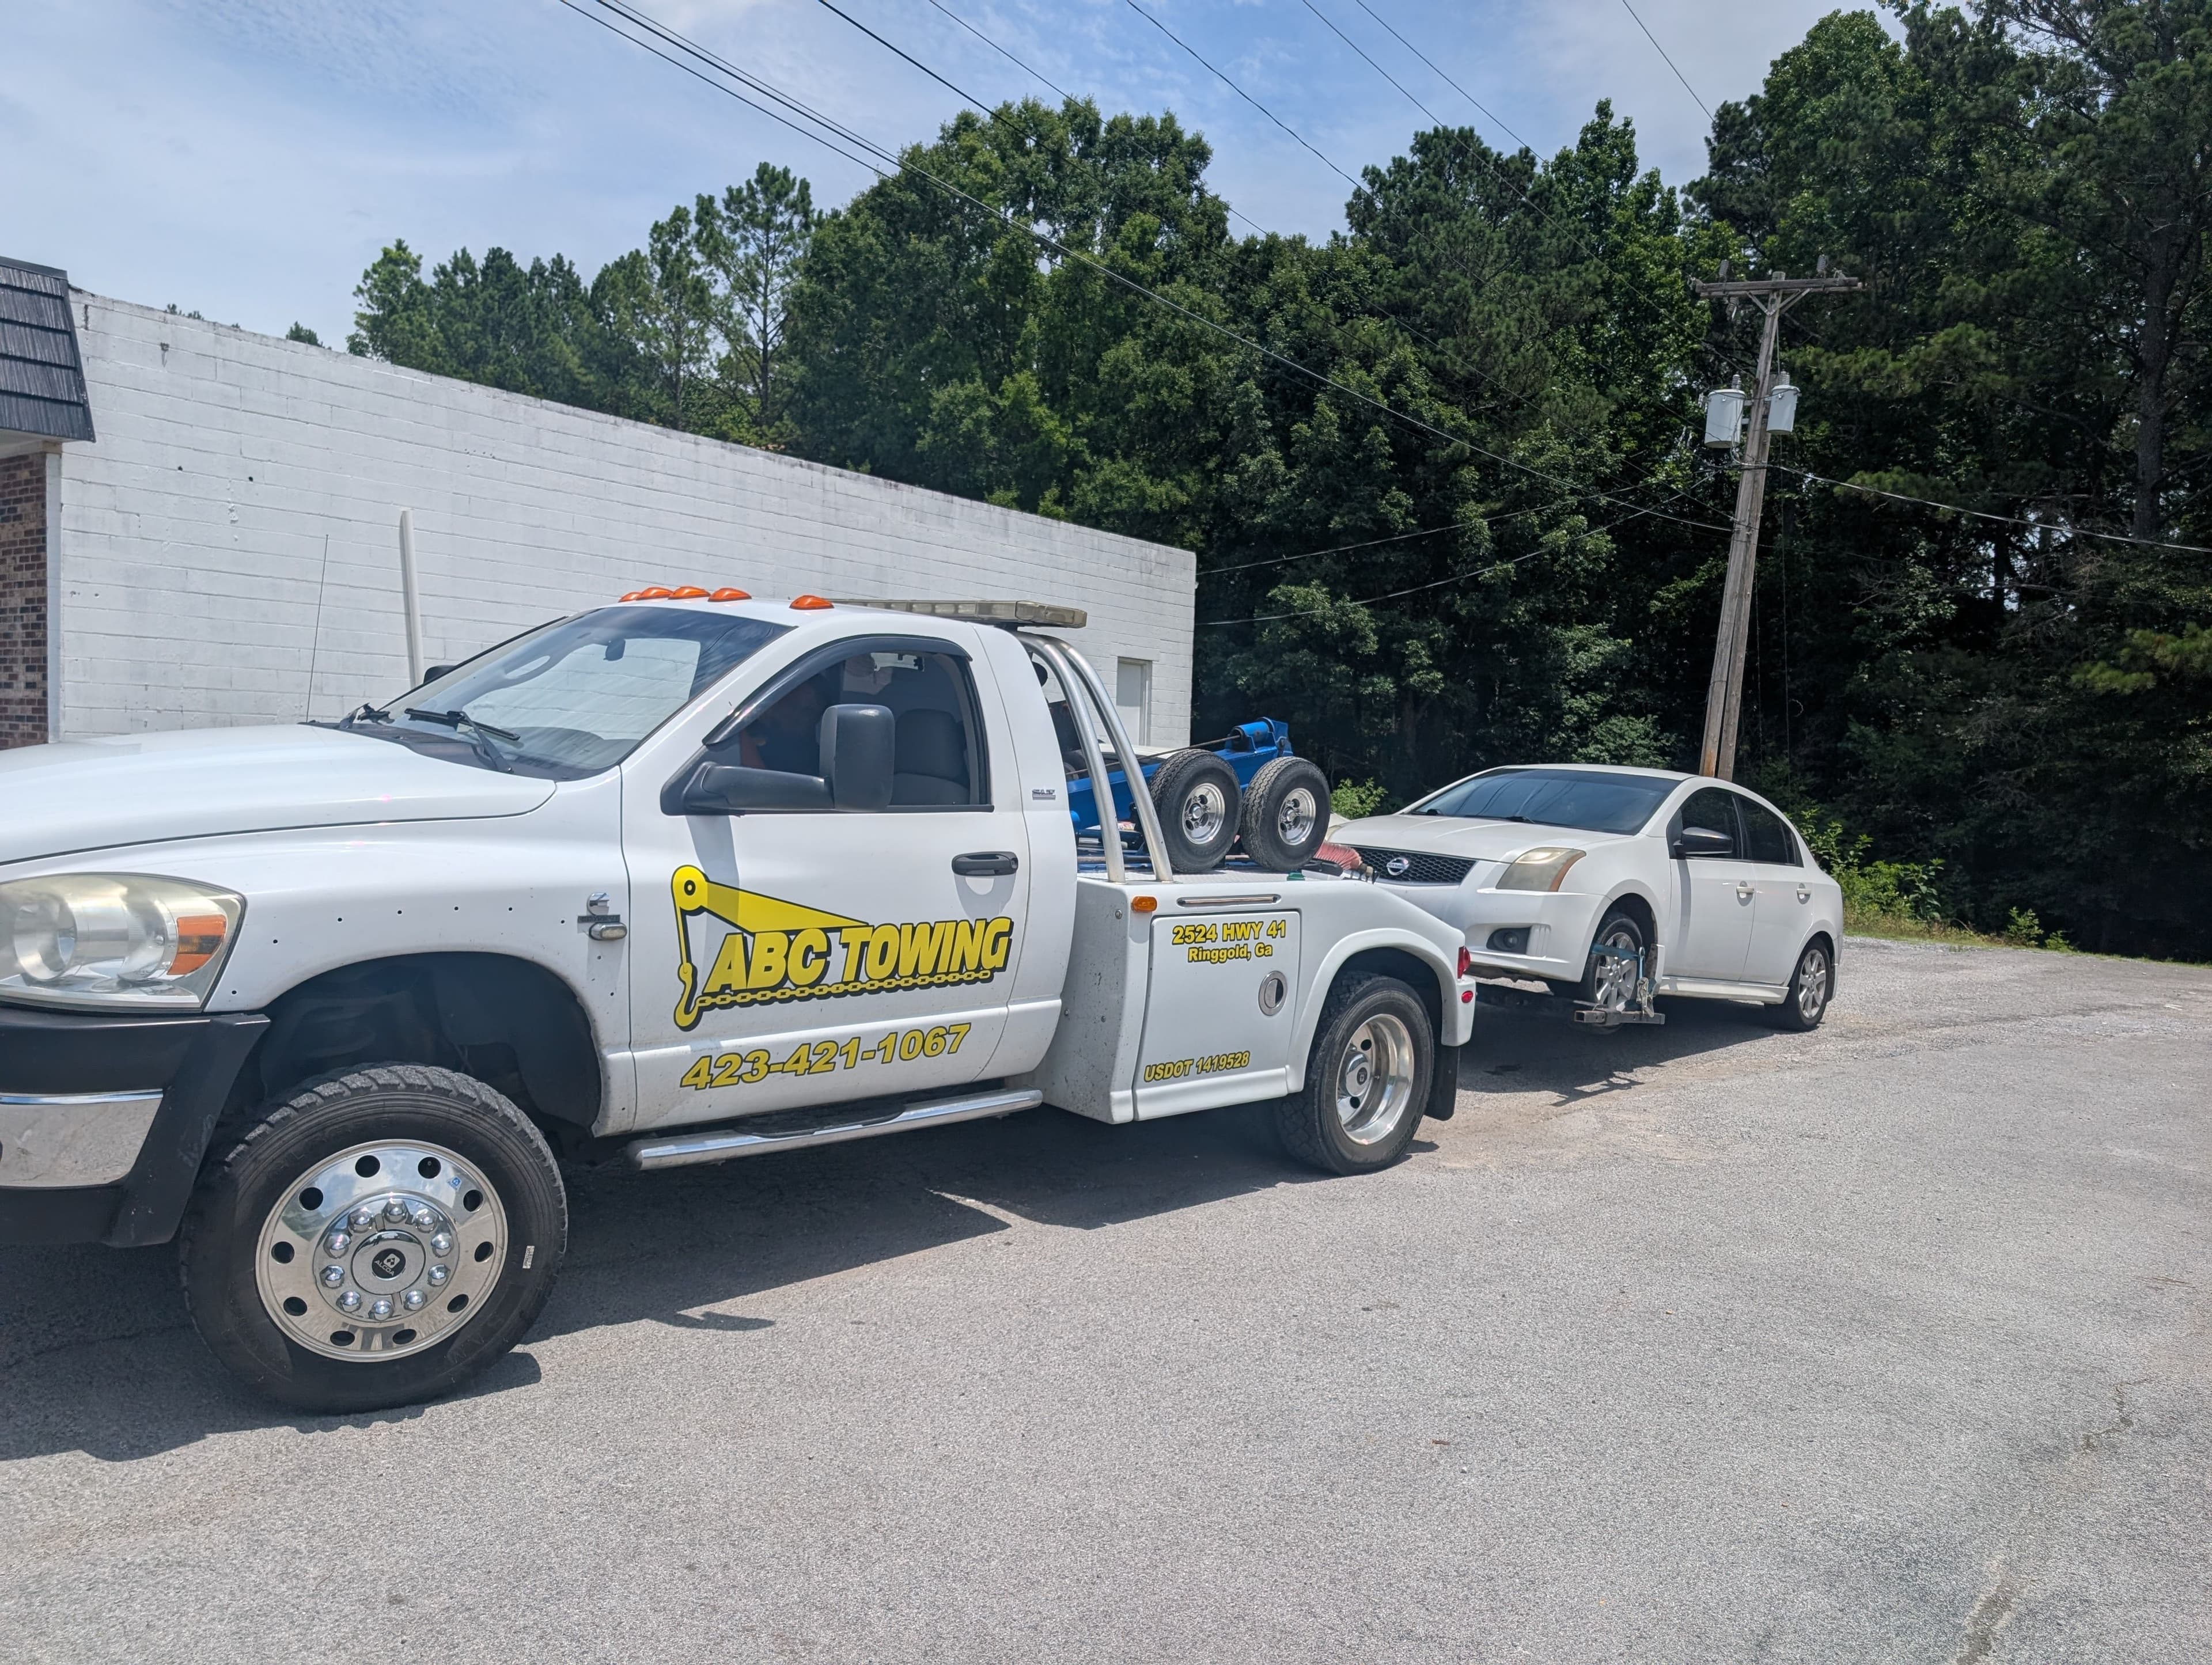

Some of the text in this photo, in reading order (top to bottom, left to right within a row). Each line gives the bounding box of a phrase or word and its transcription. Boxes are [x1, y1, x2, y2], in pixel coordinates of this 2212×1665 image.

[1172, 920, 1286, 945] 2524 HWY 41
[702, 917, 1013, 994] ABC TOWING
[1188, 942, 1272, 964] Ringgold, Ga
[680, 1023, 971, 1090] 423-421-1067
[1144, 1050, 1251, 1082] USDOT 1419528
[374, 1260, 395, 1277] ALCOA
